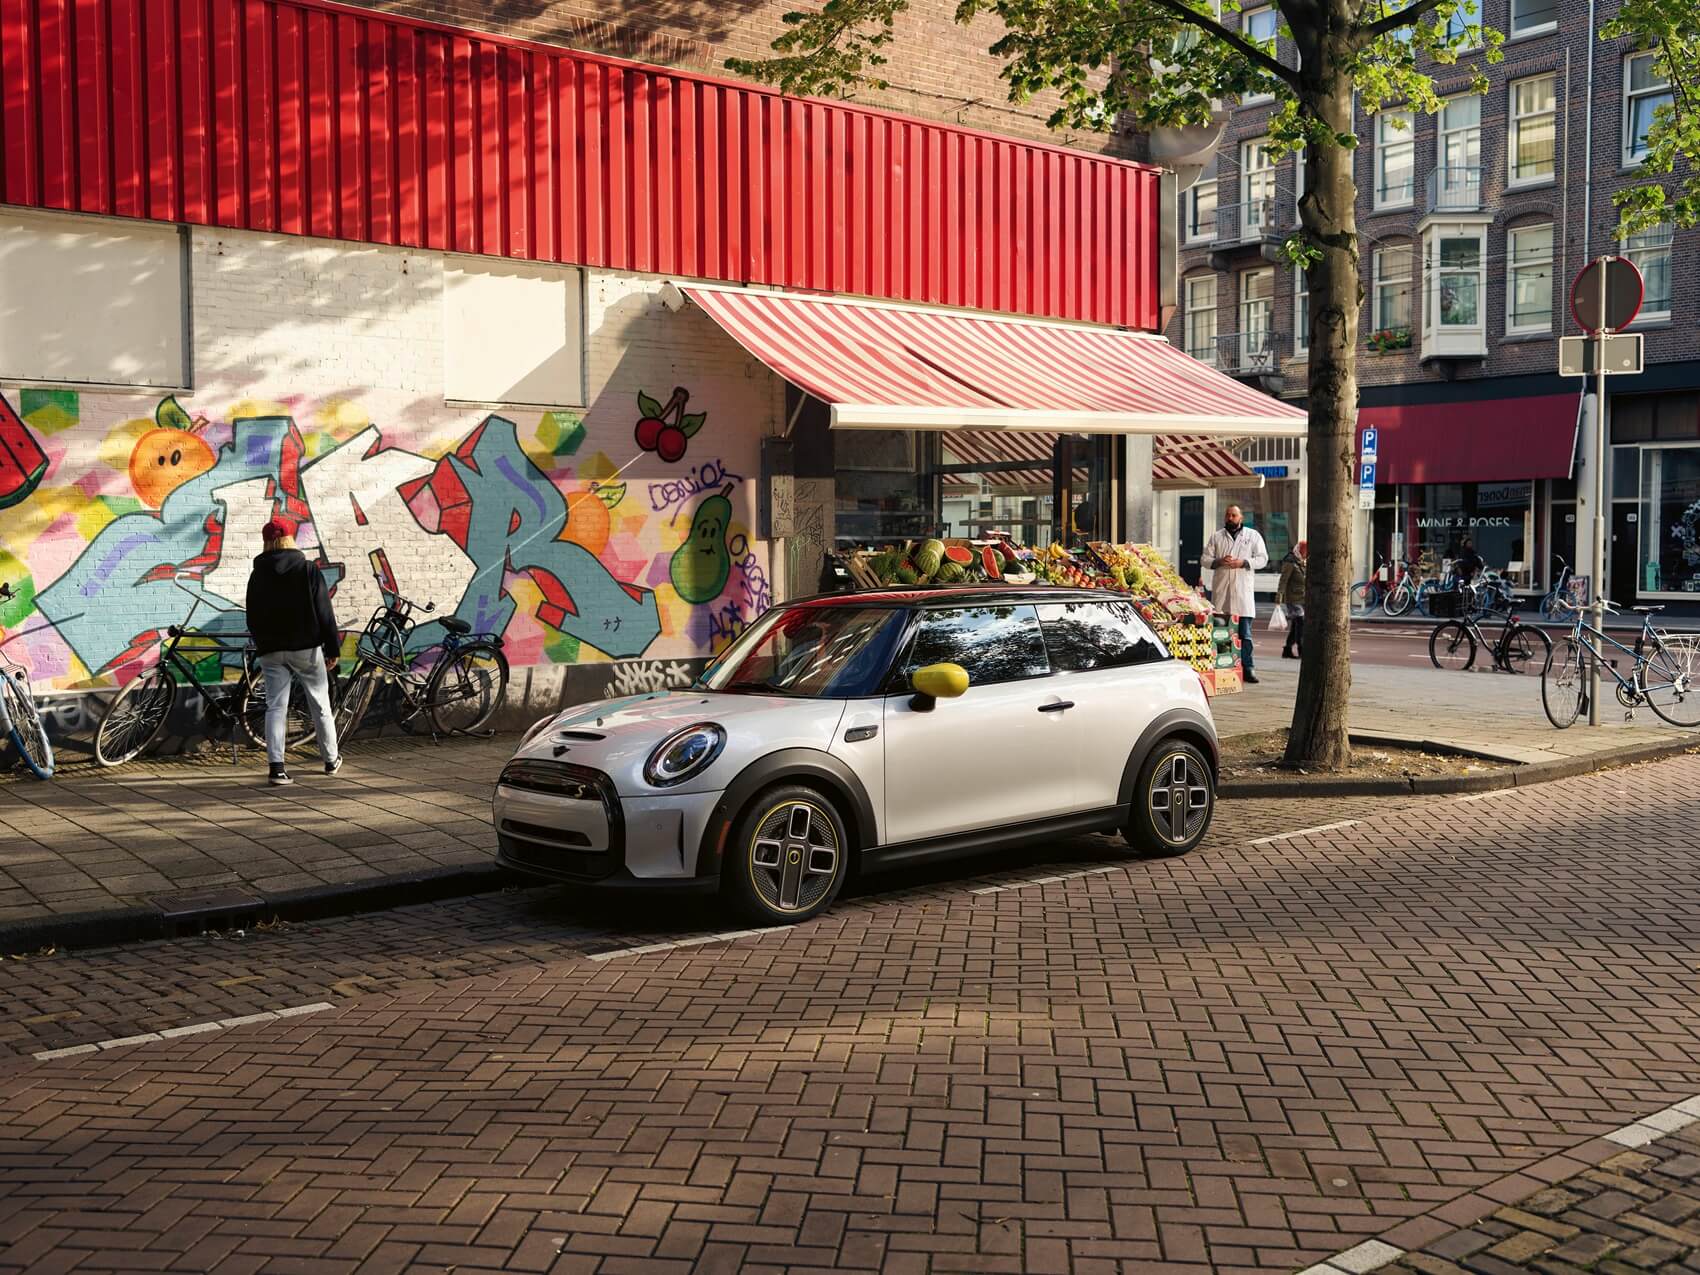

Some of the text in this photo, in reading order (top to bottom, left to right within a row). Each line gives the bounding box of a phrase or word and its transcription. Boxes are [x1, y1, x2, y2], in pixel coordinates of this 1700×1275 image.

[1365, 431, 1374, 446] P
[1363, 465, 1372, 480] P
[1416, 517, 1510, 527] WINE & ROSES
[574, 784, 586, 798] S
